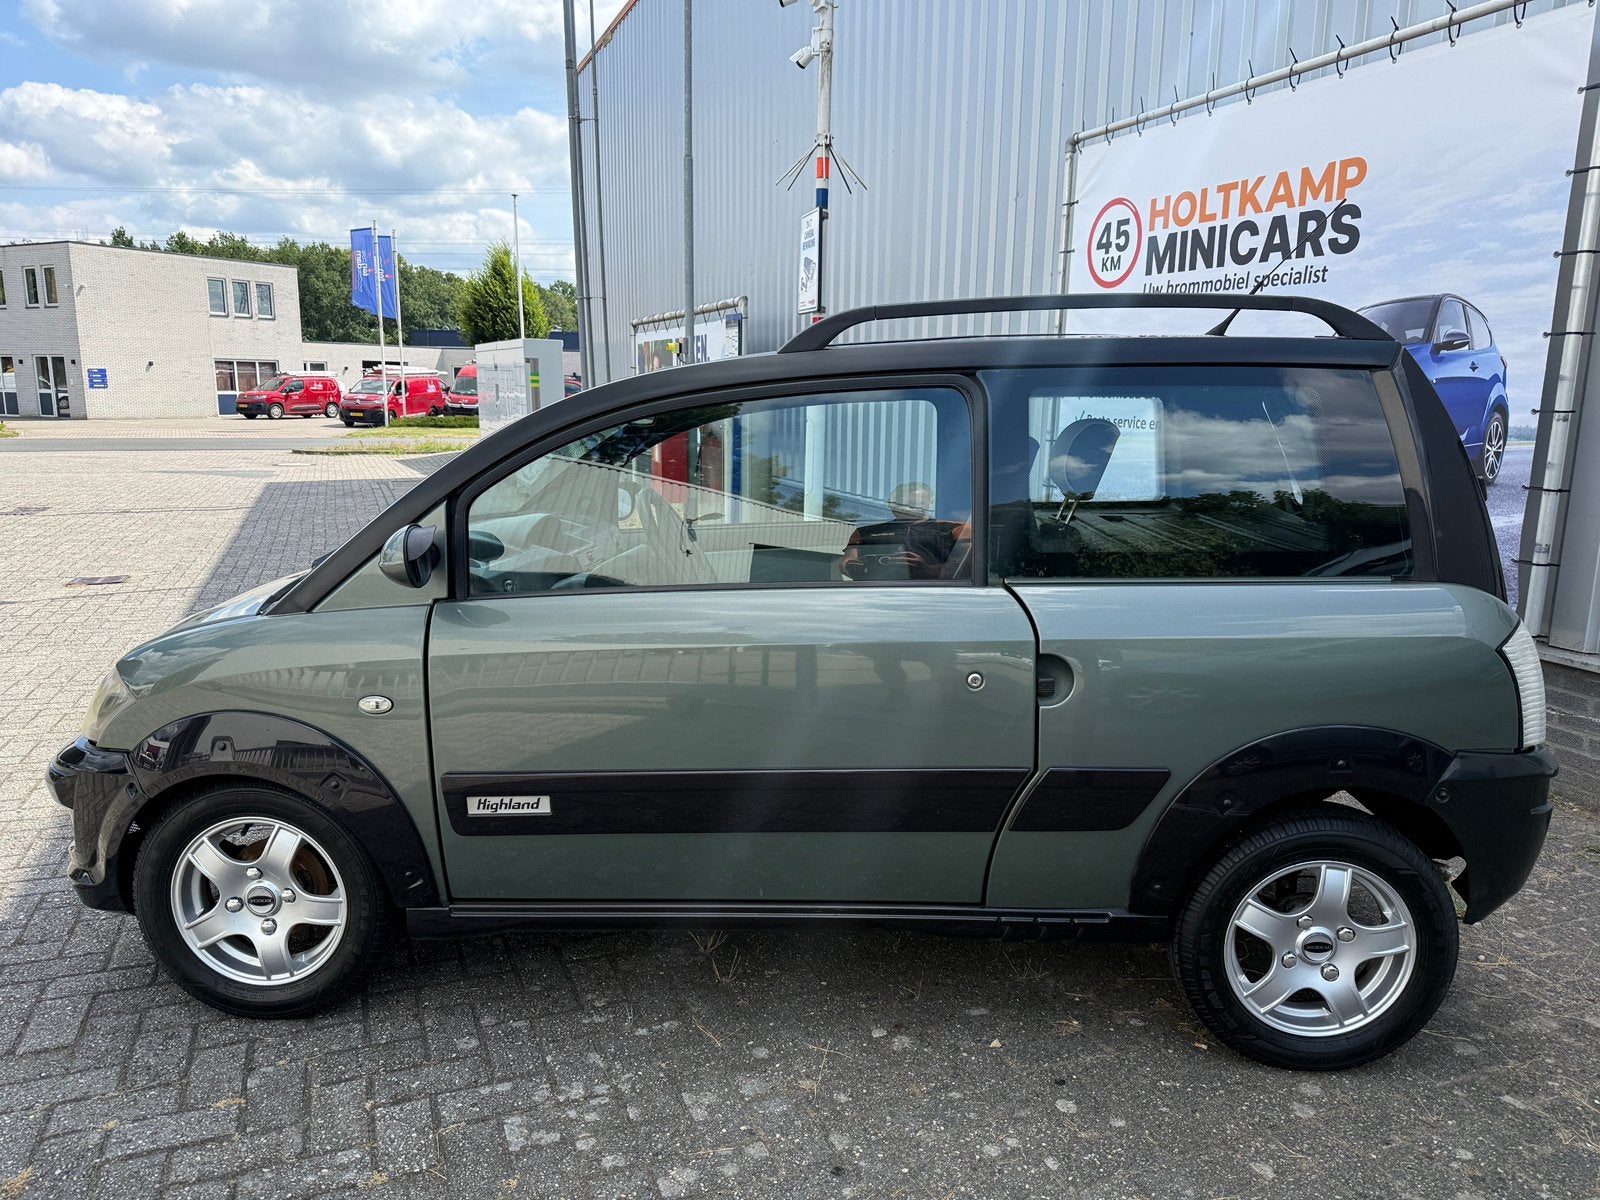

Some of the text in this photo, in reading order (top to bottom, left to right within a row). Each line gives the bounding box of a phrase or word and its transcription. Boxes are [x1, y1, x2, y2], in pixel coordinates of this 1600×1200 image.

[1148, 156, 1368, 232] HOLTKAMP
[1096, 218, 1130, 255] 45
[1145, 203, 1362, 276] MINICARS
[1101, 255, 1122, 272] KM
[1166, 271, 1251, 294] brommobiel
[1253, 265, 1328, 292] specialist
[1113, 416, 1147, 430] service
[476, 797, 541, 813] Highland
